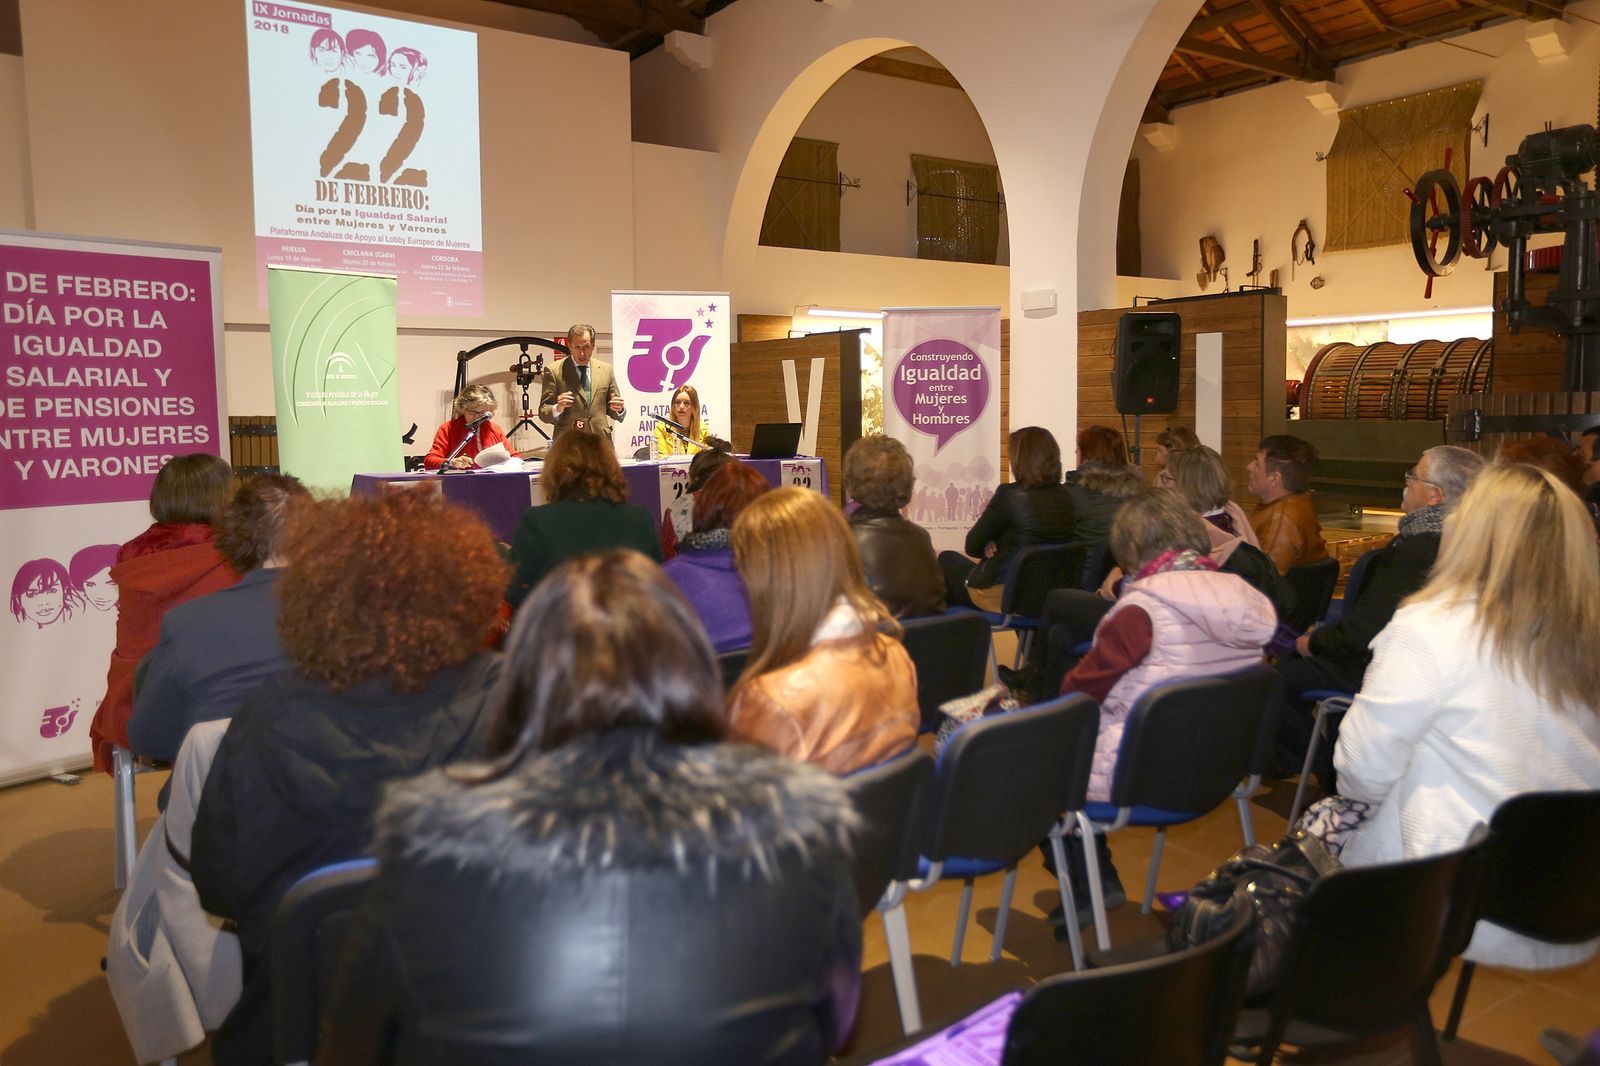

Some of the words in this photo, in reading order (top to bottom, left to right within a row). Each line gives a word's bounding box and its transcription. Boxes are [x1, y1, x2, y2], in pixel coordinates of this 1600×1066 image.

[254, 3, 269, 16] IX
[272, 7, 331, 26] Jornadas
[254, 20, 289, 34] 2018
[318, 77, 428, 187] 22
[315, 180, 339, 203] DE
[343, 185, 430, 211] FEBRERO:
[295, 204, 315, 214] Día
[318, 207, 338, 217] por
[341, 208, 352, 217] la
[355, 209, 404, 222] Igualdad
[406, 213, 448, 225] Salarial
[296, 217, 332, 228] entre
[335, 217, 385, 231] Mujeres
[388, 223, 396, 232] y
[400, 223, 448, 235] Varones
[270, 226, 309, 238] Plataforma
[310, 229, 343, 241] Andaluza
[344, 233, 354, 241] de
[354, 233, 377, 243] Apoyo
[377, 235, 385, 243] al
[385, 235, 406, 246] Lobby
[407, 237, 435, 247] Europeo
[435, 240, 445, 248] de
[446, 240, 471, 250] Mujeres
[281, 245, 307, 254] HUELVA
[6, 271, 48, 294] DE
[57, 275, 196, 302] FEBRERO:
[3, 299, 56, 326] DÍA
[64, 306, 125, 329] POR
[133, 310, 168, 330] LA
[13, 335, 163, 359] IGUALDAD
[910, 353, 973, 361] Construyendo
[6, 366, 148, 388] SALARIAL
[153, 368, 173, 388] Y
[901, 364, 981, 384] Igualdad
[929, 384, 954, 392] entre
[35, 397, 196, 418] PENSIONES
[915, 393, 967, 406] Mujeres
[938, 405, 944, 413] y
[640, 404, 708, 417] PLATAA
[912, 413, 970, 424] Hombres
[0, 428, 72, 450] NTRE
[80, 425, 210, 448] MUJERES
[14, 460, 34, 481] Y
